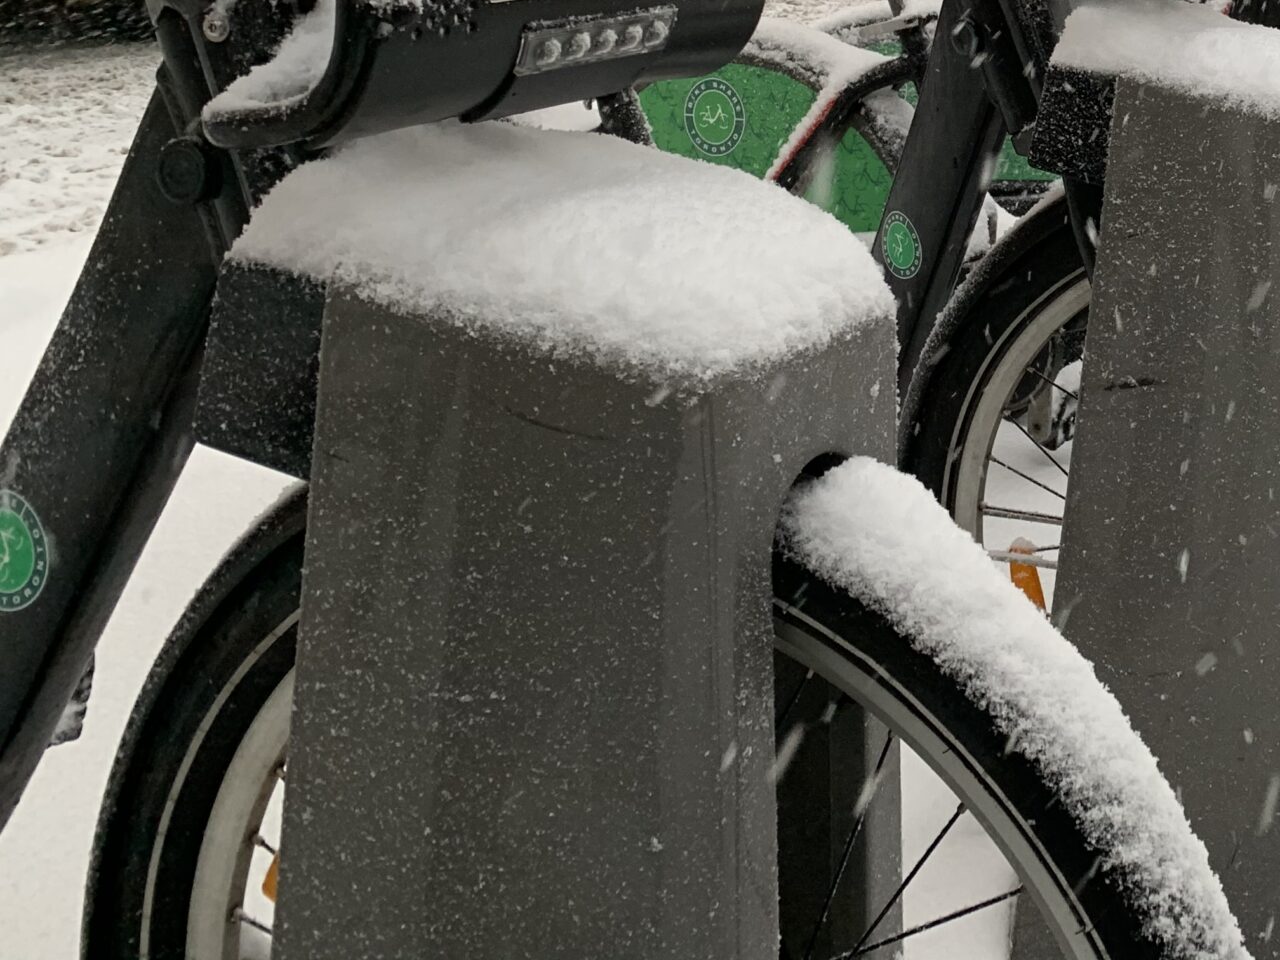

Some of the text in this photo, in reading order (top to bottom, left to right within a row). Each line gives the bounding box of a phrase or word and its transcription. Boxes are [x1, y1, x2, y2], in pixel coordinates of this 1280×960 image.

[688, 83, 706, 108] BIKE
[690, 129, 738, 153] TORONTO
[2, 528, 43, 605] TORONTO
